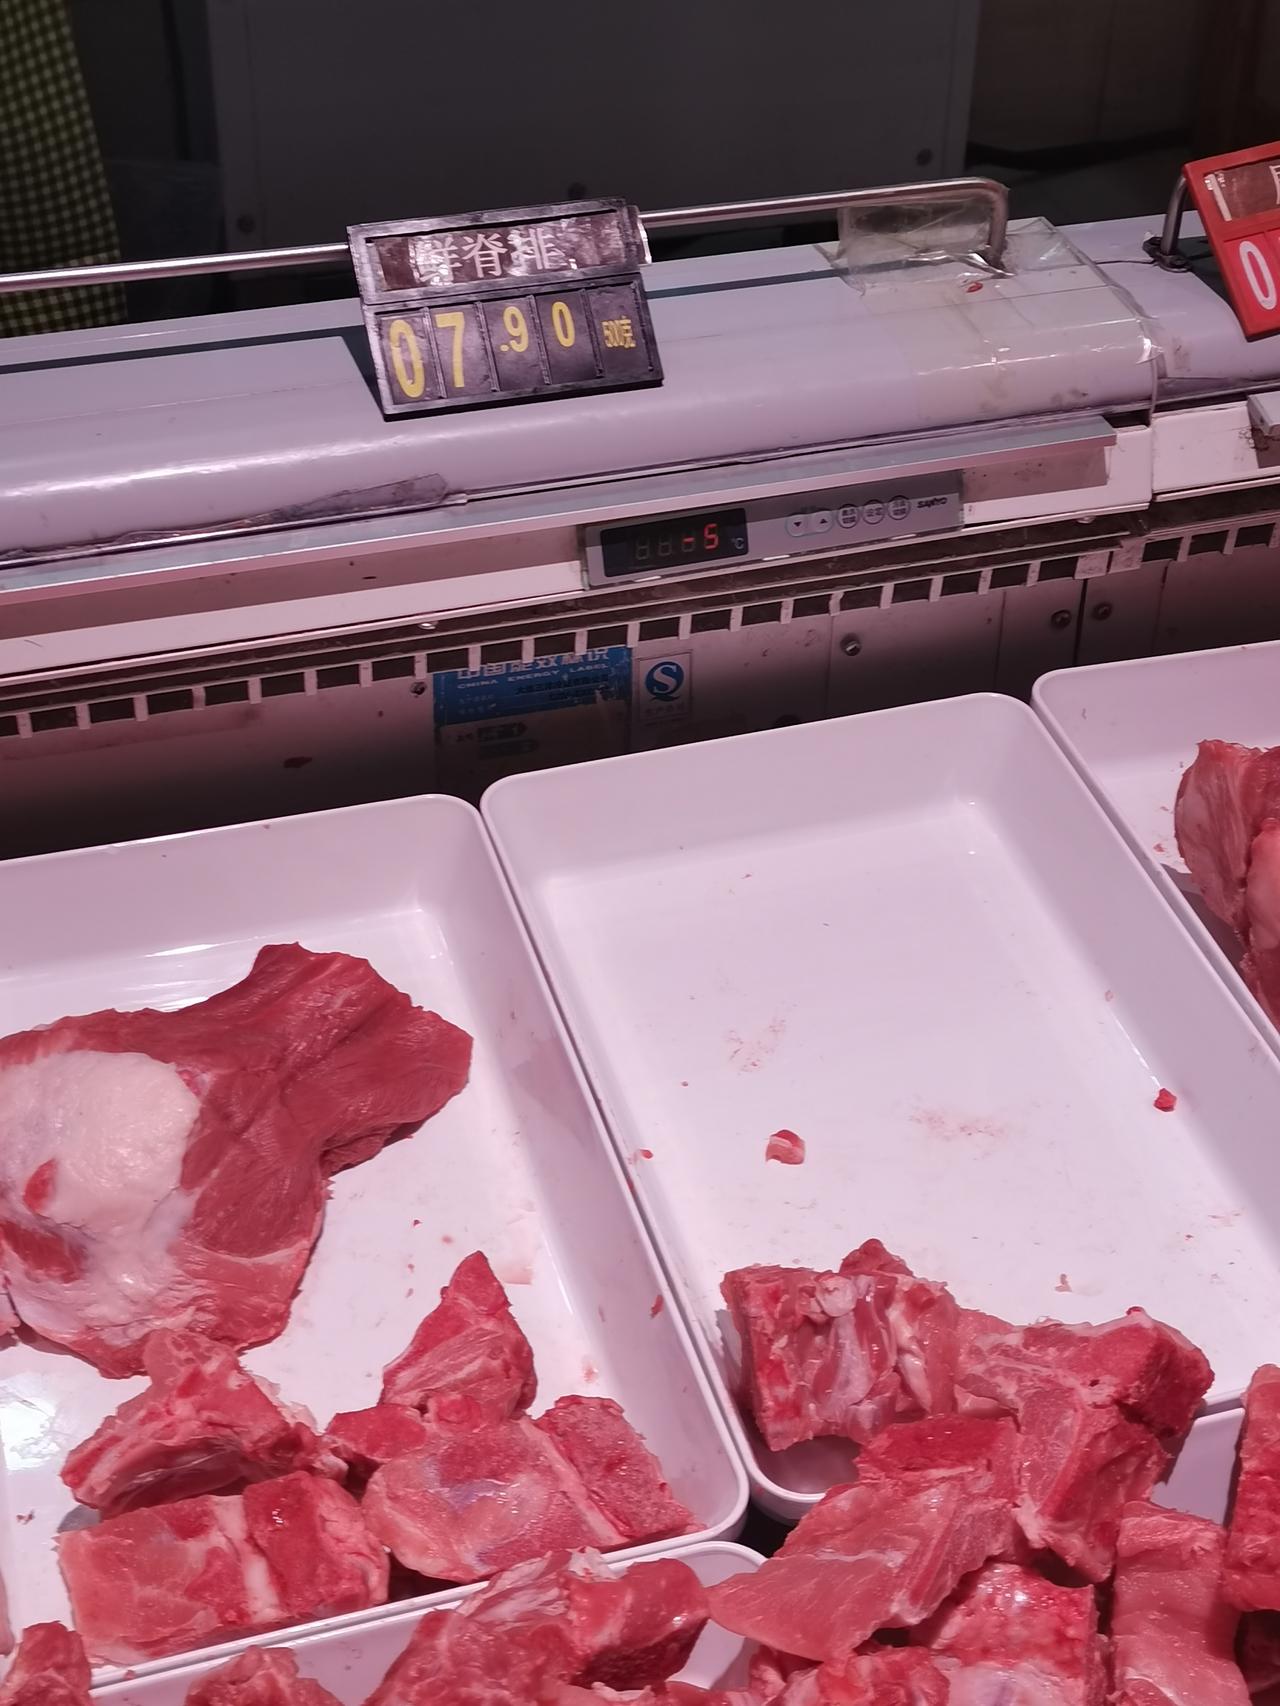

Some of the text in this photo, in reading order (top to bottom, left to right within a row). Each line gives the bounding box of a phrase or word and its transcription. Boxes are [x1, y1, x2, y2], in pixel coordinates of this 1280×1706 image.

[456, 662, 609, 690] CHINA ENERGY LABEL
